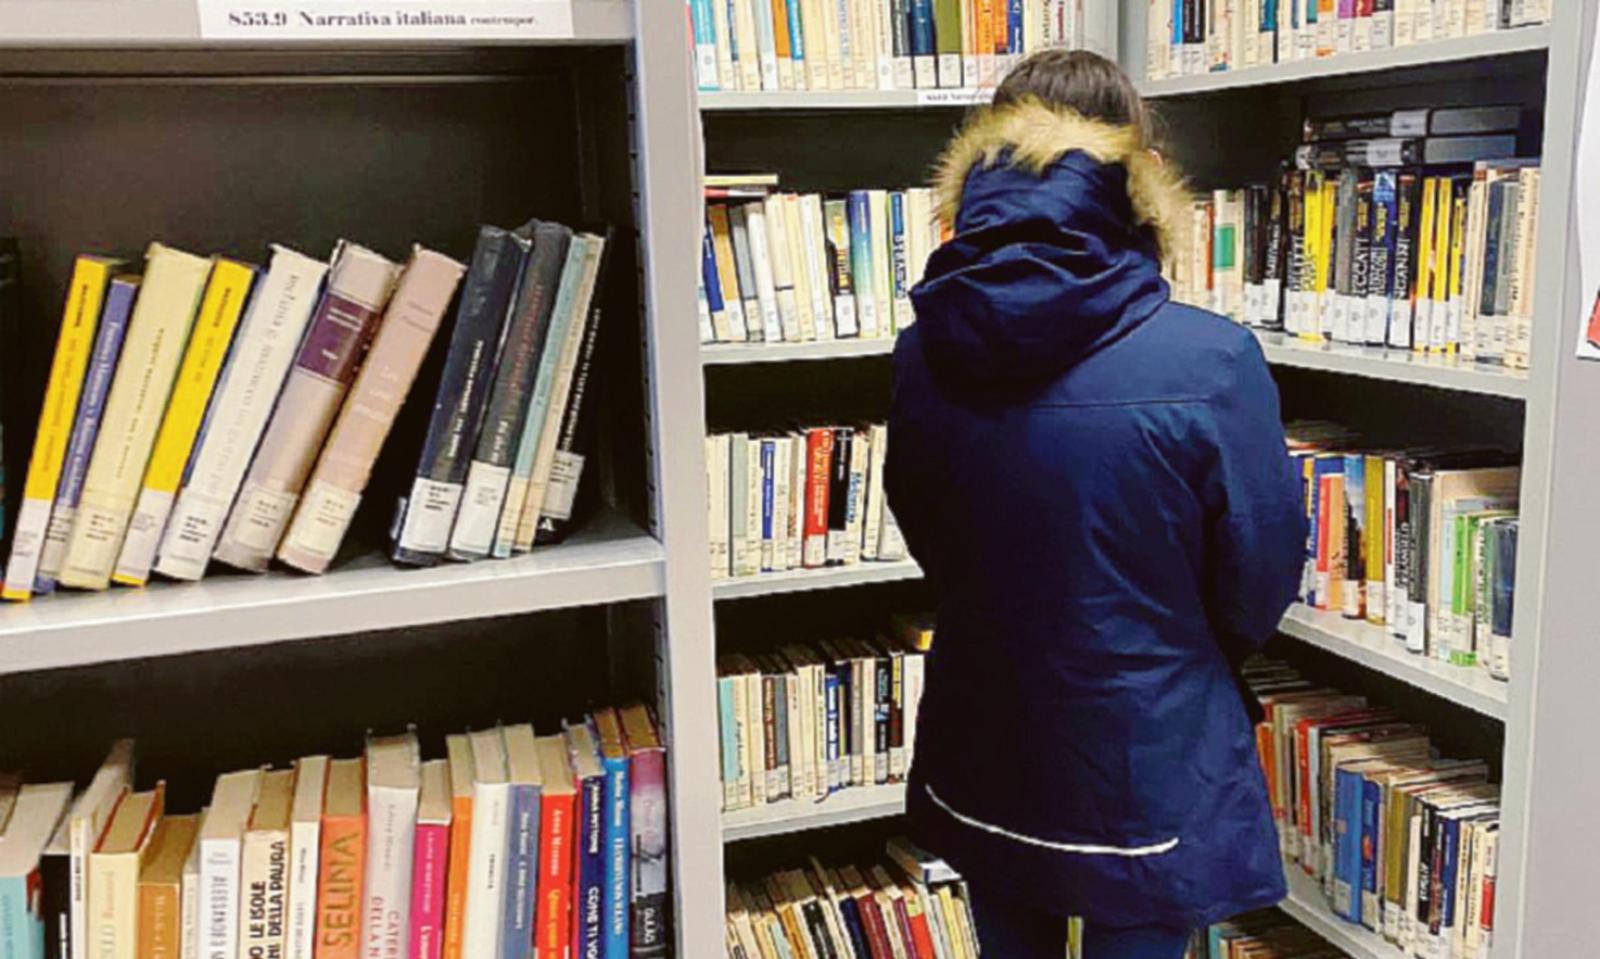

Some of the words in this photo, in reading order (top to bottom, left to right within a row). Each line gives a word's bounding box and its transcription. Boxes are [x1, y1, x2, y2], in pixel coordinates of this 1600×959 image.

[228, 11, 287, 27] 853.9
[299, 11, 391, 27] Narrativa
[398, 11, 467, 26] italiana
[268, 840, 286, 891] PAURA
[249, 881, 267, 921] ISOLE
[321, 831, 360, 951] SELINA
[586, 886, 600, 924] COME
[249, 923, 266, 939] LE
[267, 892, 283, 937] DELLA
